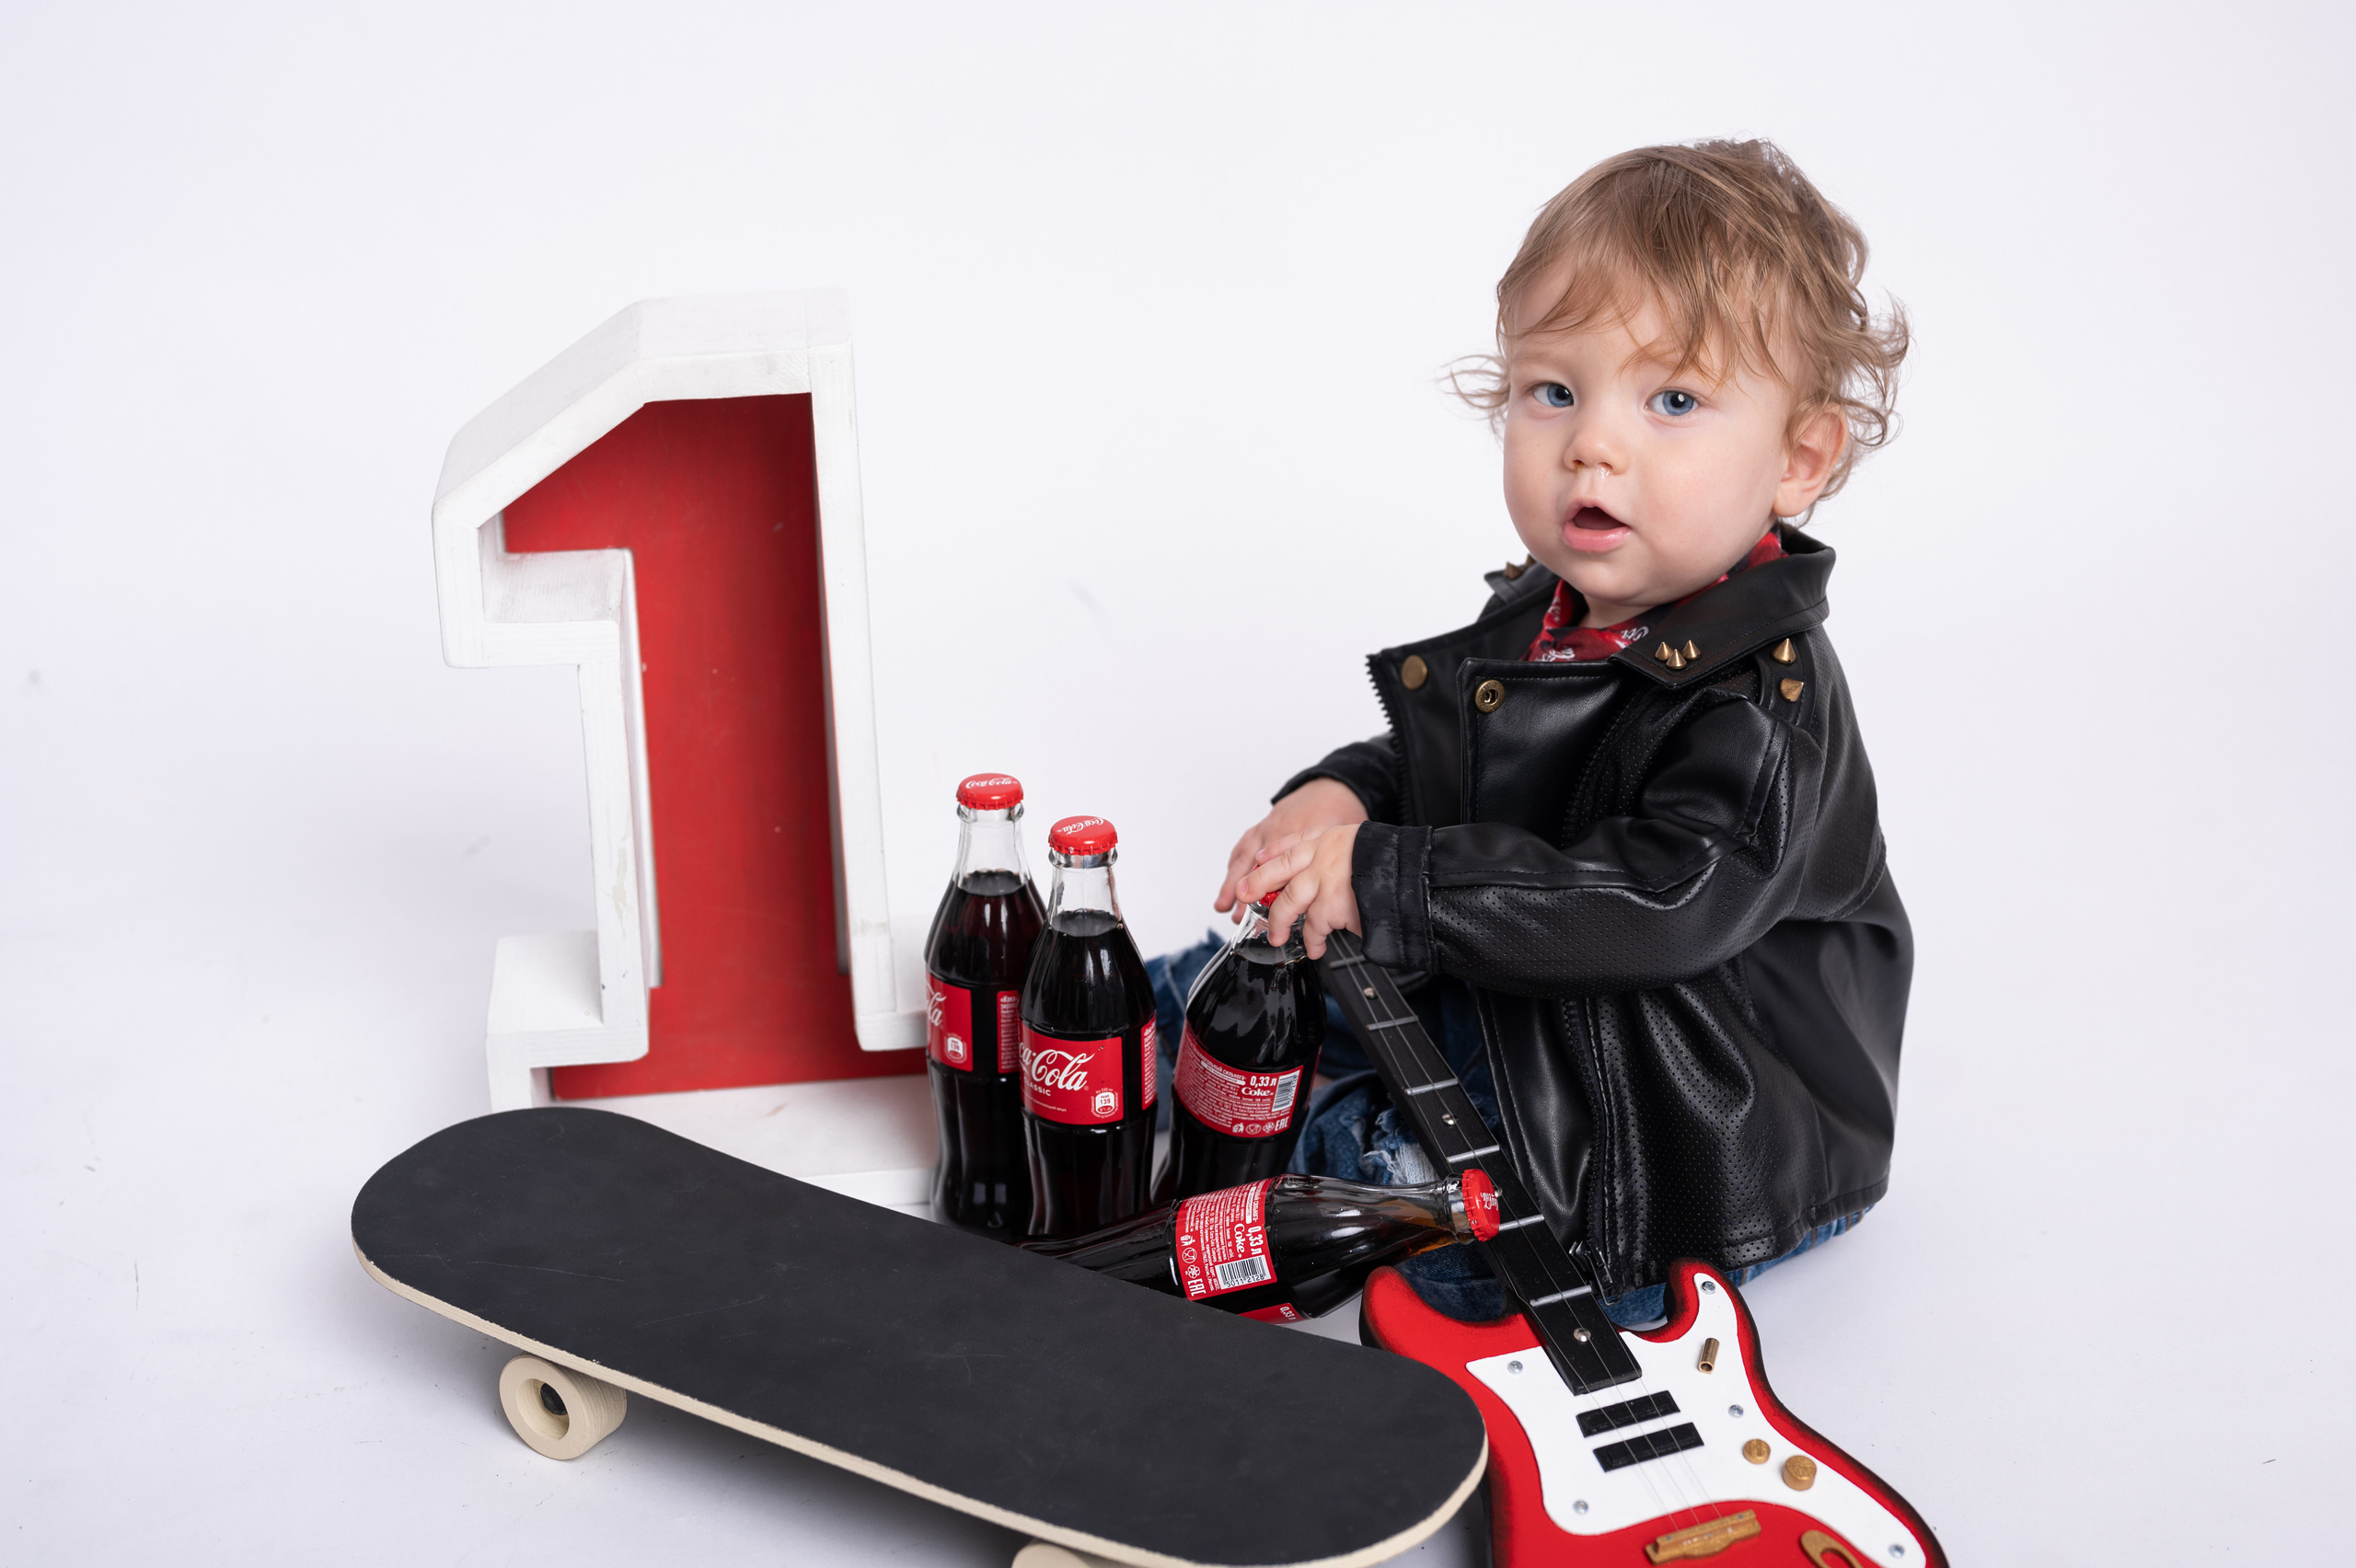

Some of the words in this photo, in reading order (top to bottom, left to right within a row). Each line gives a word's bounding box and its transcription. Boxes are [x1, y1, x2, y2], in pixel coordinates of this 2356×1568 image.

[965, 777, 1012, 789] Coca-Cola
[1062, 816, 1104, 836] Coca-Cola
[1019, 1042, 1095, 1091] ca-Cola
[1250, 1076, 1270, 1088] 0,33
[1241, 1087, 1271, 1097] Coke
[1233, 1223, 1246, 1253] Coke
[1245, 1226, 1264, 1247] 0,33
[1246, 1274, 1265, 1283] 2128
